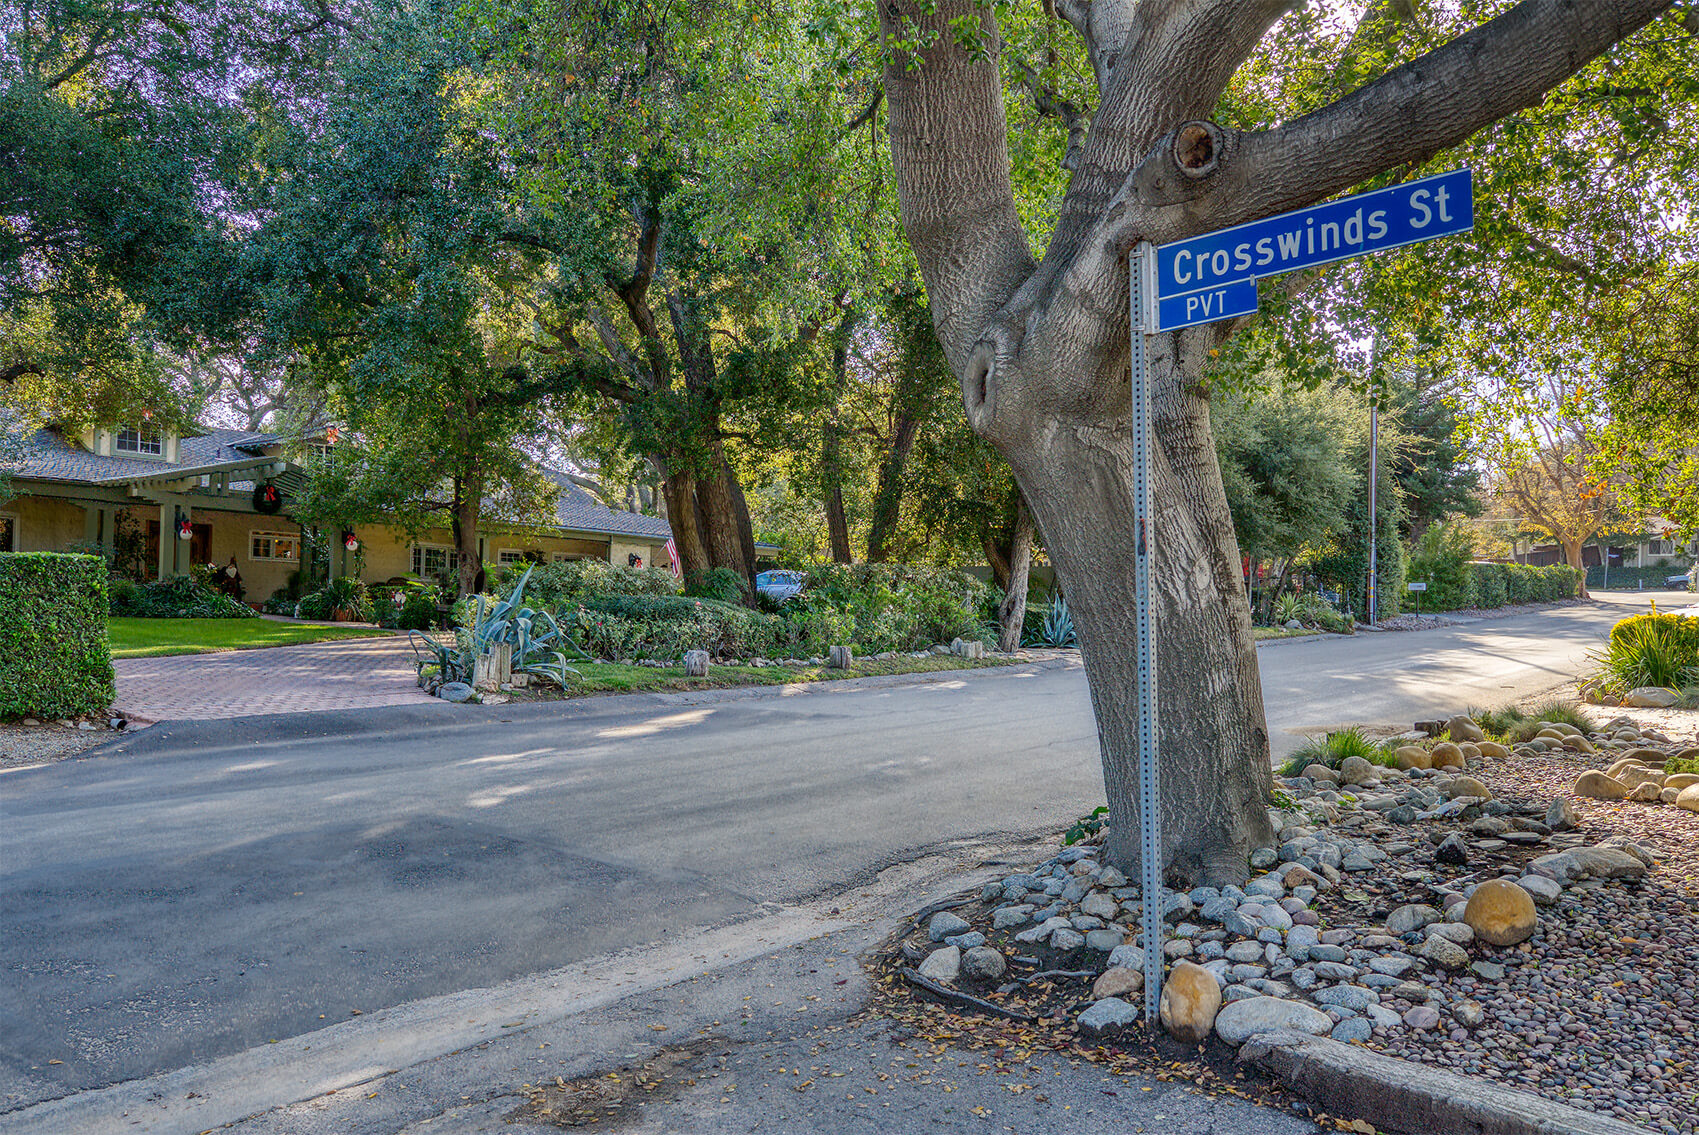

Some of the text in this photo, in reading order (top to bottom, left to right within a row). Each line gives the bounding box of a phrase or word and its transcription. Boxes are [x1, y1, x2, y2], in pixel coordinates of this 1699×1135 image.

[1174, 185, 1453, 284] Crosswinds St
[1186, 290, 1227, 320] PVT
